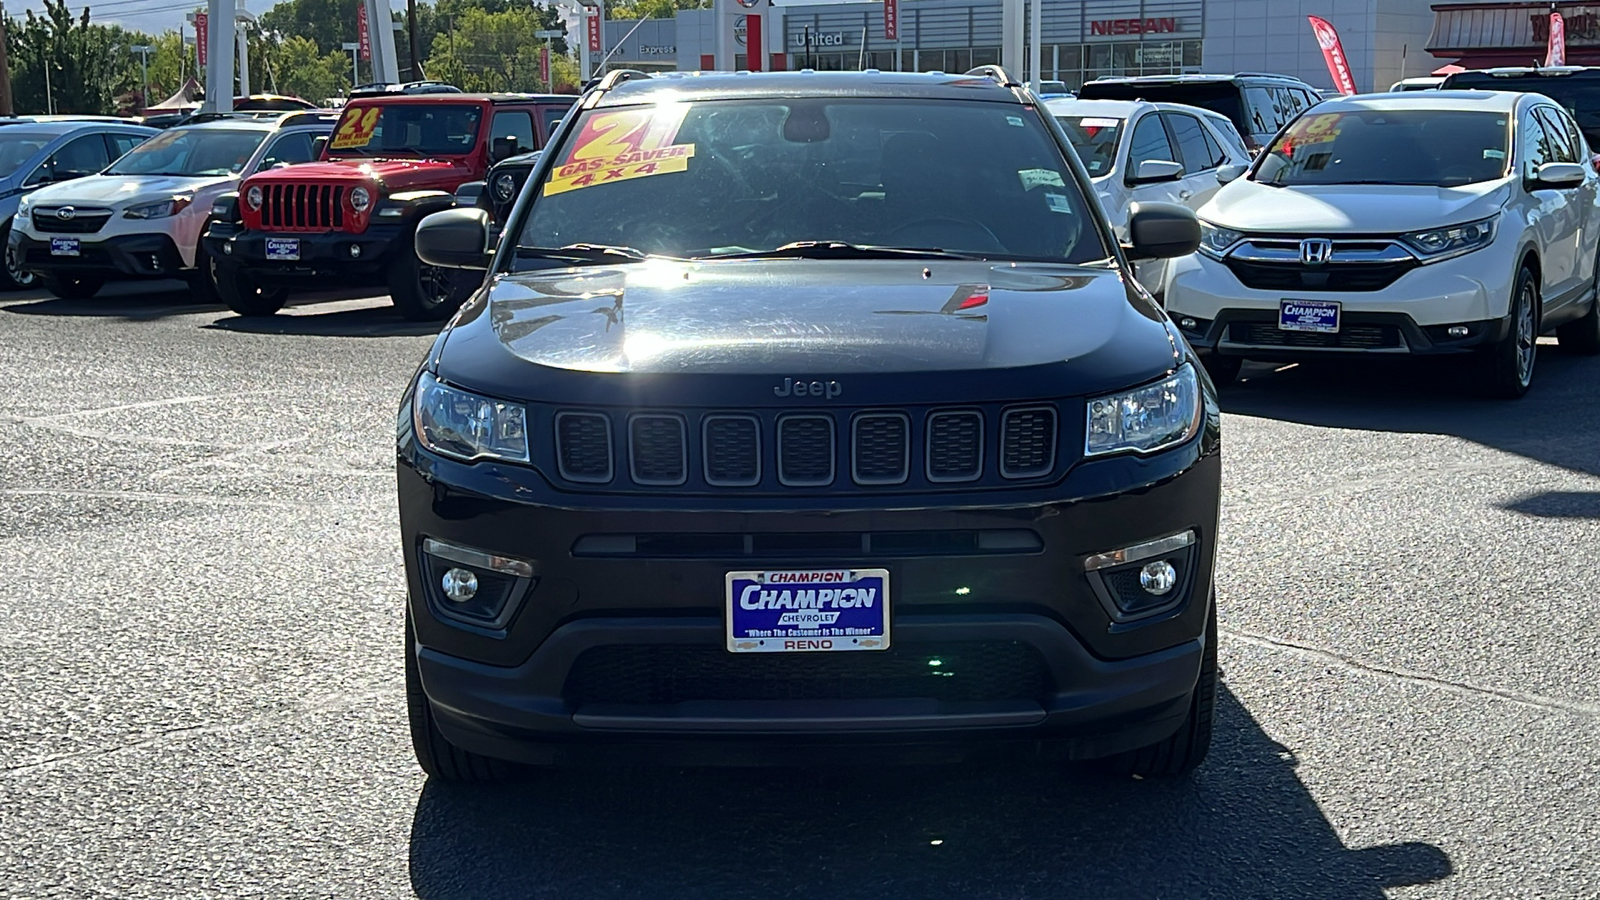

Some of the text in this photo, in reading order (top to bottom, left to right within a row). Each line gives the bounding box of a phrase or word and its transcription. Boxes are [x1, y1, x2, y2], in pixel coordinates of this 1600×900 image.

[886, 0, 895, 36] ISSAN
[1091, 17, 1175, 36] NISSAN
[361, 18, 370, 57] NISSAN
[590, 16, 598, 48] ISSAN
[796, 31, 843, 46] United
[640, 45, 675, 55] Express
[339, 107, 379, 134] 24
[1290, 113, 1340, 137] 18
[574, 110, 684, 160] 21
[559, 147, 686, 177] GAS-SAVER
[571, 173, 594, 186] 4
[634, 163, 658, 174] 4
[1284, 304, 1336, 317] CHAMPION
[774, 377, 842, 400] Jeep
[770, 571, 844, 583] CHAMPION
[740, 585, 876, 610] CHAMPION
[782, 614, 835, 623] CHEVROLET
[773, 629, 786, 637] The
[789, 628, 821, 637] Customer
[823, 628, 830, 636] Is
[832, 628, 844, 636] The
[784, 640, 833, 650] RENO
